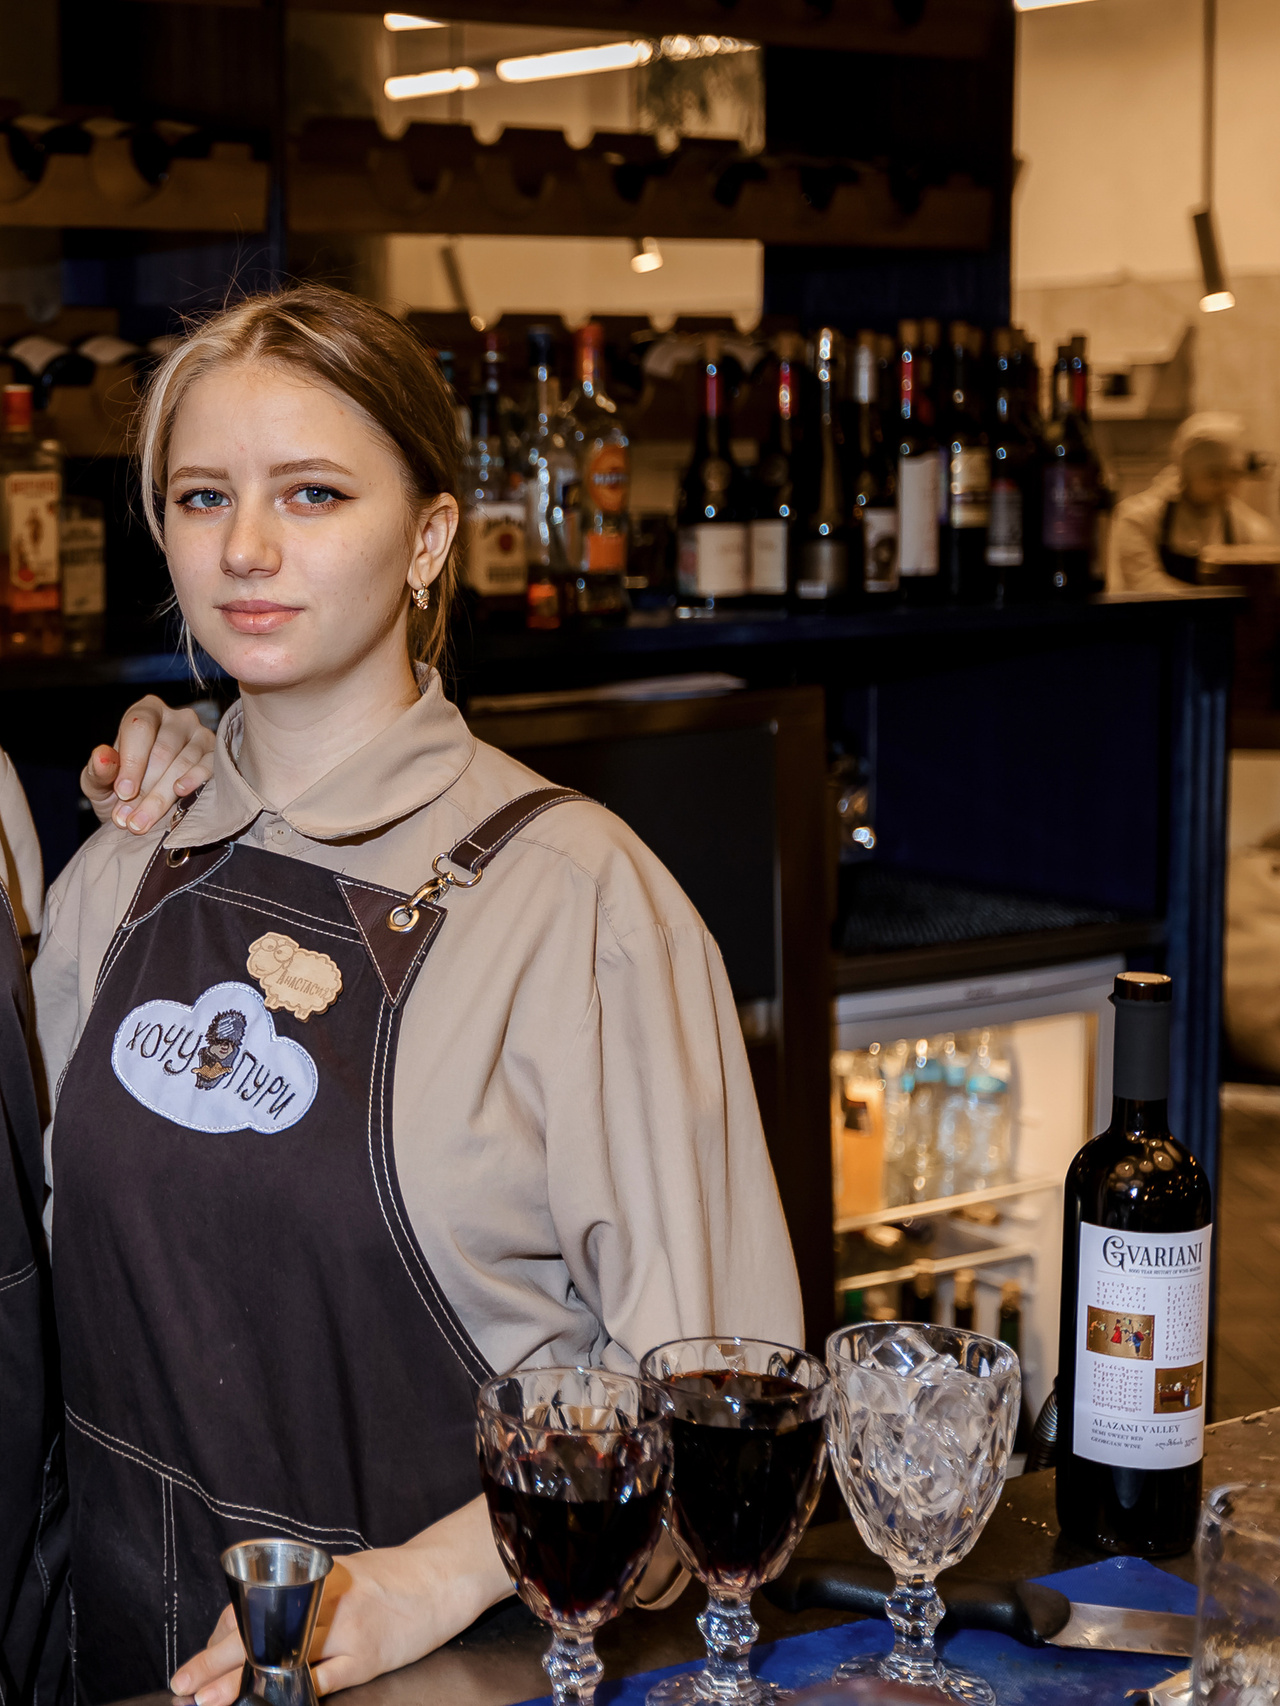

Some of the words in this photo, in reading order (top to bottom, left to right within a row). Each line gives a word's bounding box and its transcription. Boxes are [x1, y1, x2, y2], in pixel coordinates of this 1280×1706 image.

[125, 1020, 204, 1075] ХОЧУ
[223, 1049, 296, 1120] ПУРИ
[1092, 1418, 1138, 1433] ALAZANI
[1141, 1424, 1181, 1434] VALLEY
[1090, 1436, 1122, 1448] GEORGIAN
[1107, 1432, 1129, 1440] SWEET
